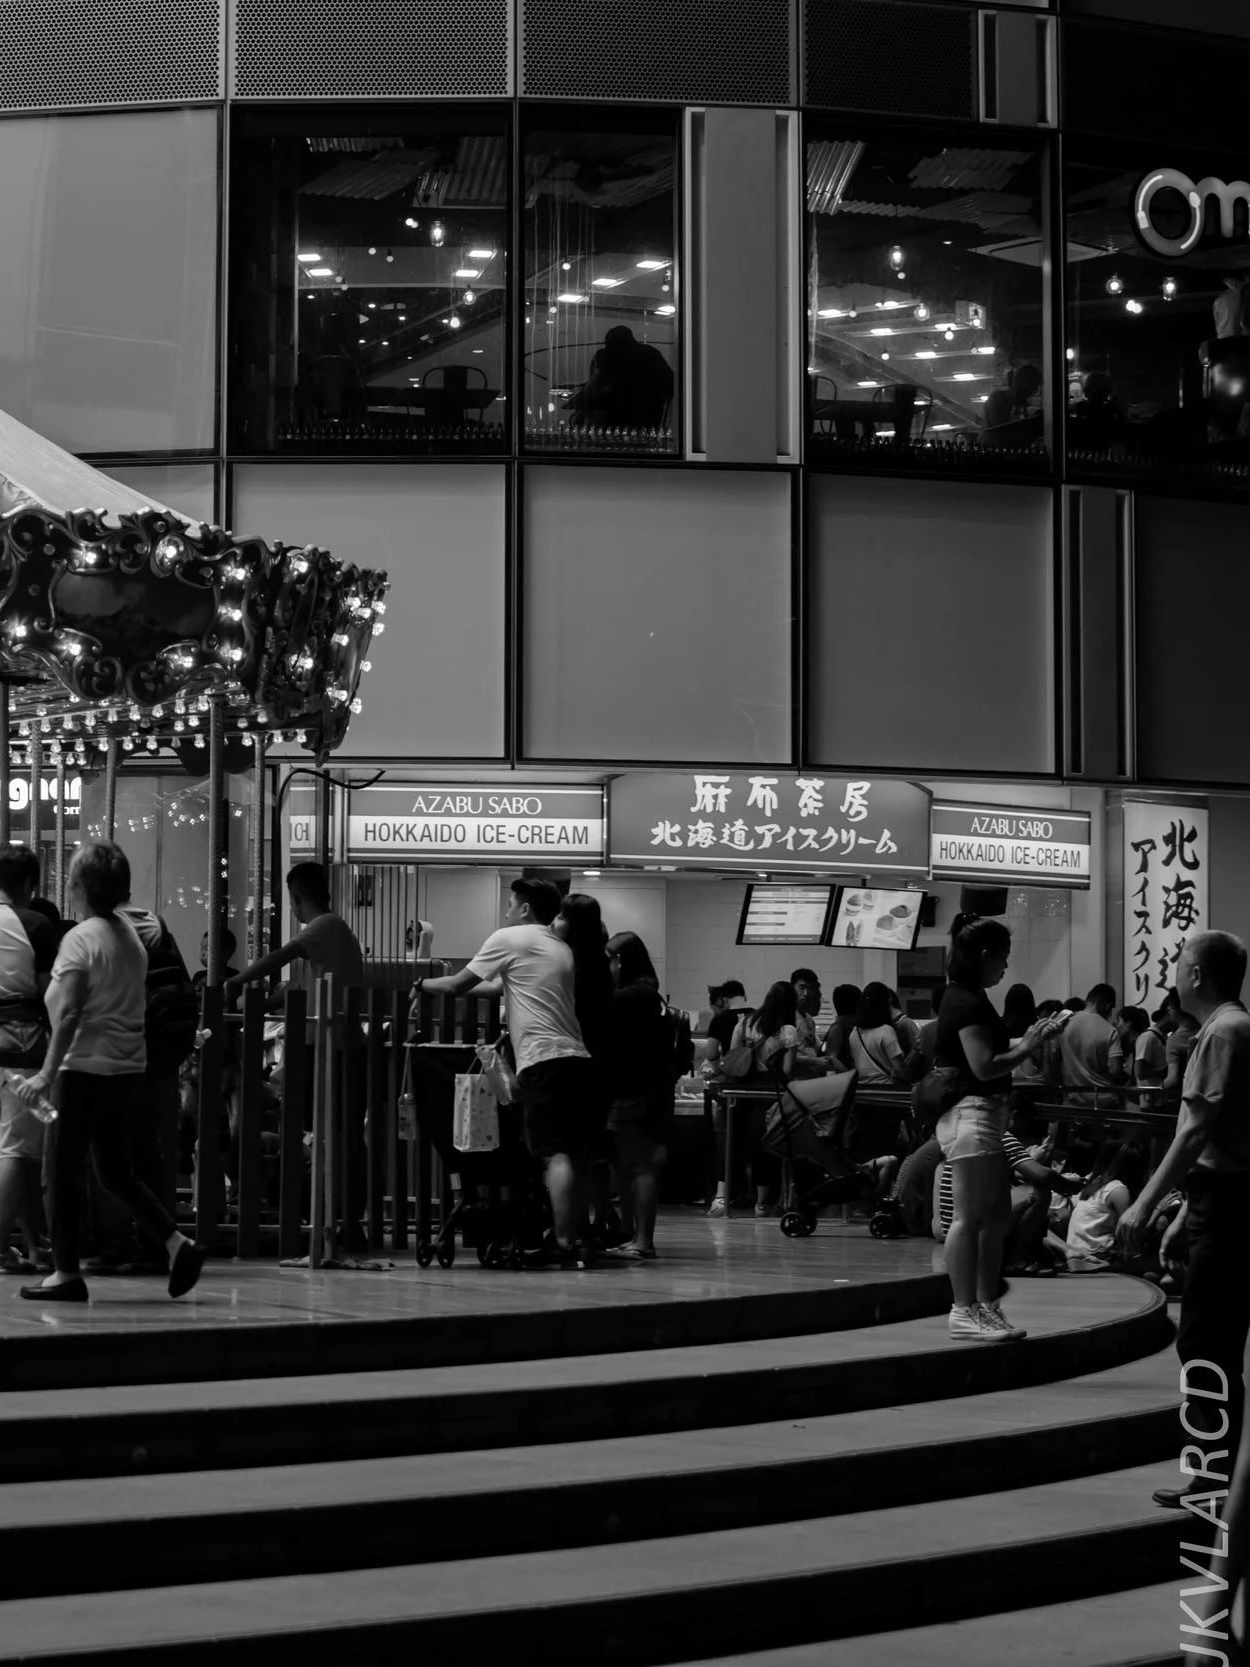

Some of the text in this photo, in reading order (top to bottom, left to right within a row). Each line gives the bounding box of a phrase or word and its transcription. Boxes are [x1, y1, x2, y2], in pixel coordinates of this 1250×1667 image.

[412, 795, 543, 815] AZABU SABO
[364, 822, 589, 845] HOKKAIDO ICE-CREAM
[650, 818, 899, 855] 北海道アイスクリーム
[970, 816, 1053, 839] AZABU SABO
[939, 840, 1081, 868] HOKKAIDO ICE-CREAM
